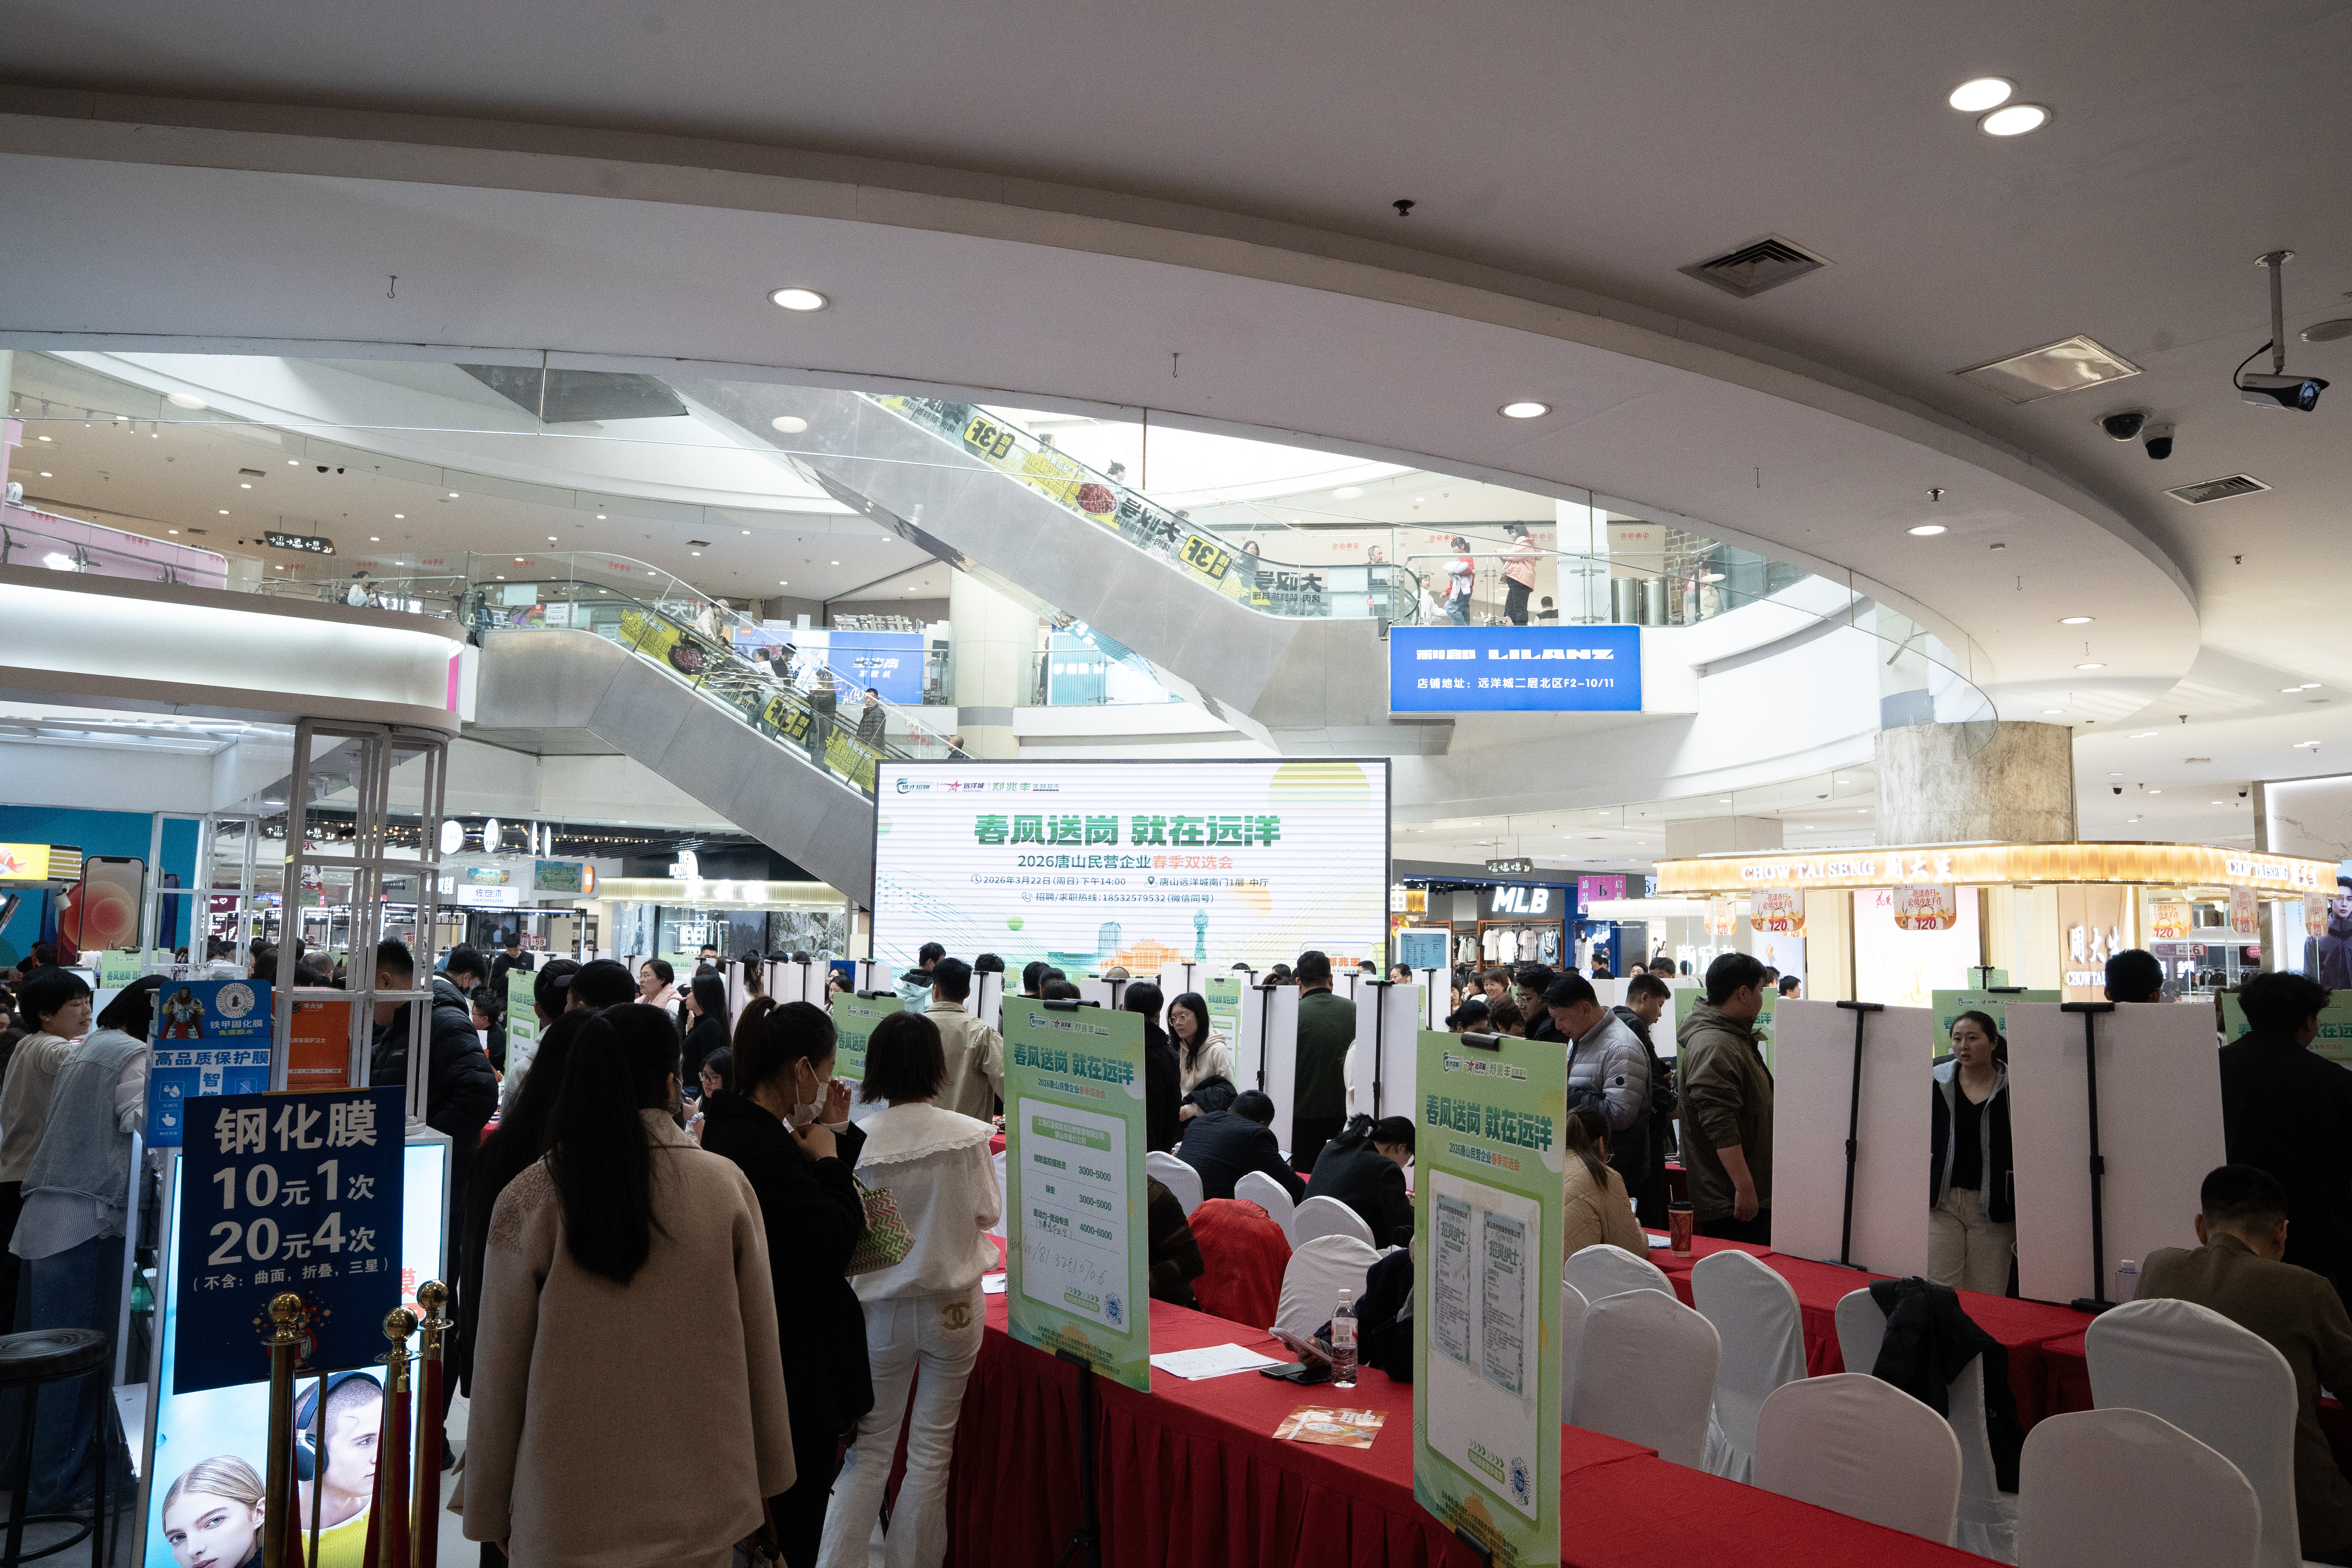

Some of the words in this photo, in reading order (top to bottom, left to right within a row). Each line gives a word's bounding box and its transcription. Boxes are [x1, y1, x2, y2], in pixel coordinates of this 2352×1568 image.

[1416, 649, 1475, 660] 利郎
[1488, 649, 1614, 660] LILANZ
[853, 657, 900, 669] 步步高
[858, 670, 891, 679] 家教机
[993, 782, 1030, 791] 郑兆丰
[975, 814, 1118, 846] 春风送岗
[1131, 815, 1281, 848] 就在远洋
[679, 851, 690, 863] THE
[1018, 855, 1234, 870] 2026唐山民营企业春季双选会
[1742, 864, 1790, 881] CHOW
[1795, 862, 1826, 878] TAI
[1828, 859, 1876, 878] SENG
[1885, 854, 1952, 880] 周大生
[2227, 859, 2252, 877] CHOW
[1160, 877, 1245, 887] 唐山远洋城南门1层
[1250, 878, 1269, 887] 中厅
[1582, 879, 1589, 901] 盛装
[1913, 889, 1936, 898] 花漾春日
[1492, 886, 1549, 913] MLB
[1767, 893, 1788, 902] 花漾春日
[1908, 897, 1943, 906] 会员沙龙手作
[1762, 900, 1793, 909] 会员沙龙手作
[1717, 926, 1728, 935] 120
[1770, 919, 1788, 931] 120
[1916, 919, 1937, 929] 120
[2241, 922, 2250, 933] 120
[2314, 925, 2322, 936] 120
[2155, 928, 2174, 938] 120
[107, 971, 131, 980] 春风送岗
[2067, 971, 2091, 986] CHOW
[210, 1020, 263, 1029] 铁甲固化膜
[1074, 1023, 1094, 1033] 郑兆丰
[155, 1051, 270, 1066] 高品质保护膜
[1014, 1043, 1068, 1074] 春风送岗
[1073, 1053, 1134, 1085] 就在远洋
[1490, 1062, 1511, 1078] 郑兆丰
[1038, 1078, 1106, 1099] 2026唐山民营企业春季双选会
[214, 1100, 377, 1154] 钢化膜
[1426, 1094, 1481, 1136] 春风送岗
[1486, 1105, 1553, 1152] 就在远洋
[1449, 1142, 1520, 1172] 2026唐山民营企业春季双选会
[1033, 1154, 1067, 1170] 消防监控值班员
[1078, 1166, 1111, 1182] 3000-5000
[213, 1159, 375, 1210] 10元1次
[1045, 1184, 1055, 1195] 保安
[1079, 1194, 1112, 1211] 3000-5000
[1080, 1223, 1112, 1240] 4000-6000
[208, 1212, 376, 1265] 20元4次
